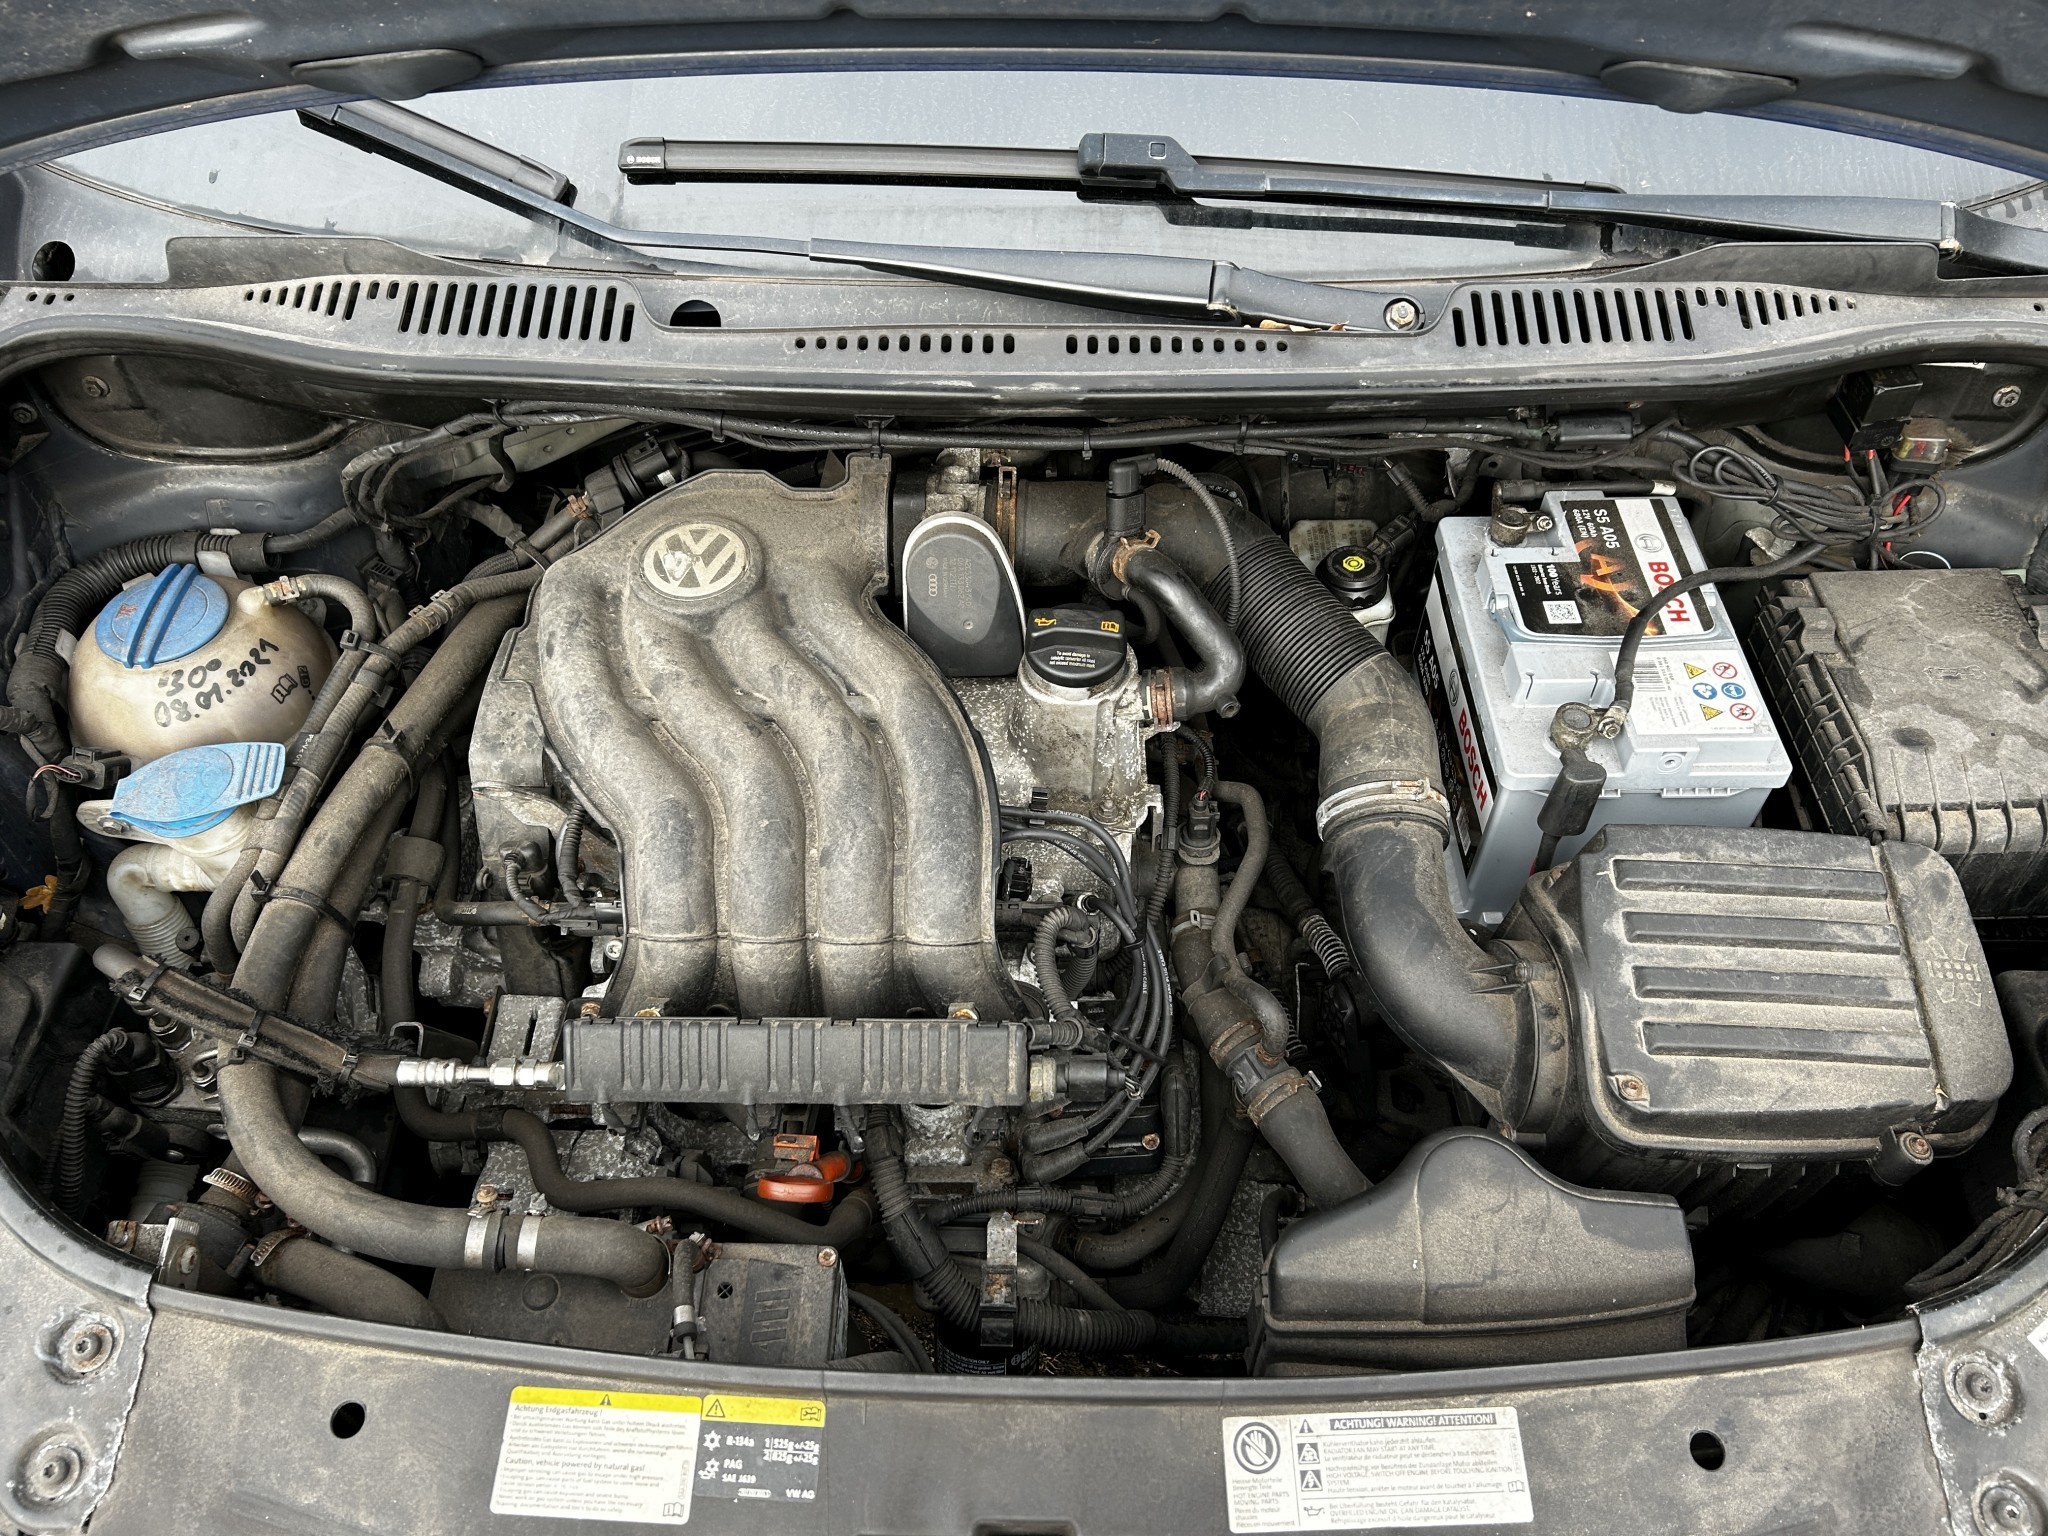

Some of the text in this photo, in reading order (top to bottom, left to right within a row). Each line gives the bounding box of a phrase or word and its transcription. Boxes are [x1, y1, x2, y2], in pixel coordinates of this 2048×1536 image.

[1582, 509, 1598, 538] 12V 60Ah
[1594, 509, 1620, 549] S5 A05
[1546, 564, 1562, 596] 100 Years
[1648, 562, 1691, 622] BOCH
[1458, 707, 1488, 812] BOSCH
[1156, 948, 1166, 967] CABLE
[514, 1404, 545, 1414] Achtung
[545, 1406, 599, 1417] Erdgasfahrzeug
[1333, 1415, 1493, 1429] ACHTUNG! WARNING! ATTENTION!
[725, 1435, 755, 1448] R-134a
[536, 1459, 560, 1467] vehicle
[561, 1460, 592, 1469] powered
[593, 1462, 603, 1470] by
[603, 1463, 629, 1471] natural
[723, 1459, 743, 1470] PAG
[785, 1488, 816, 1499] VW AG
